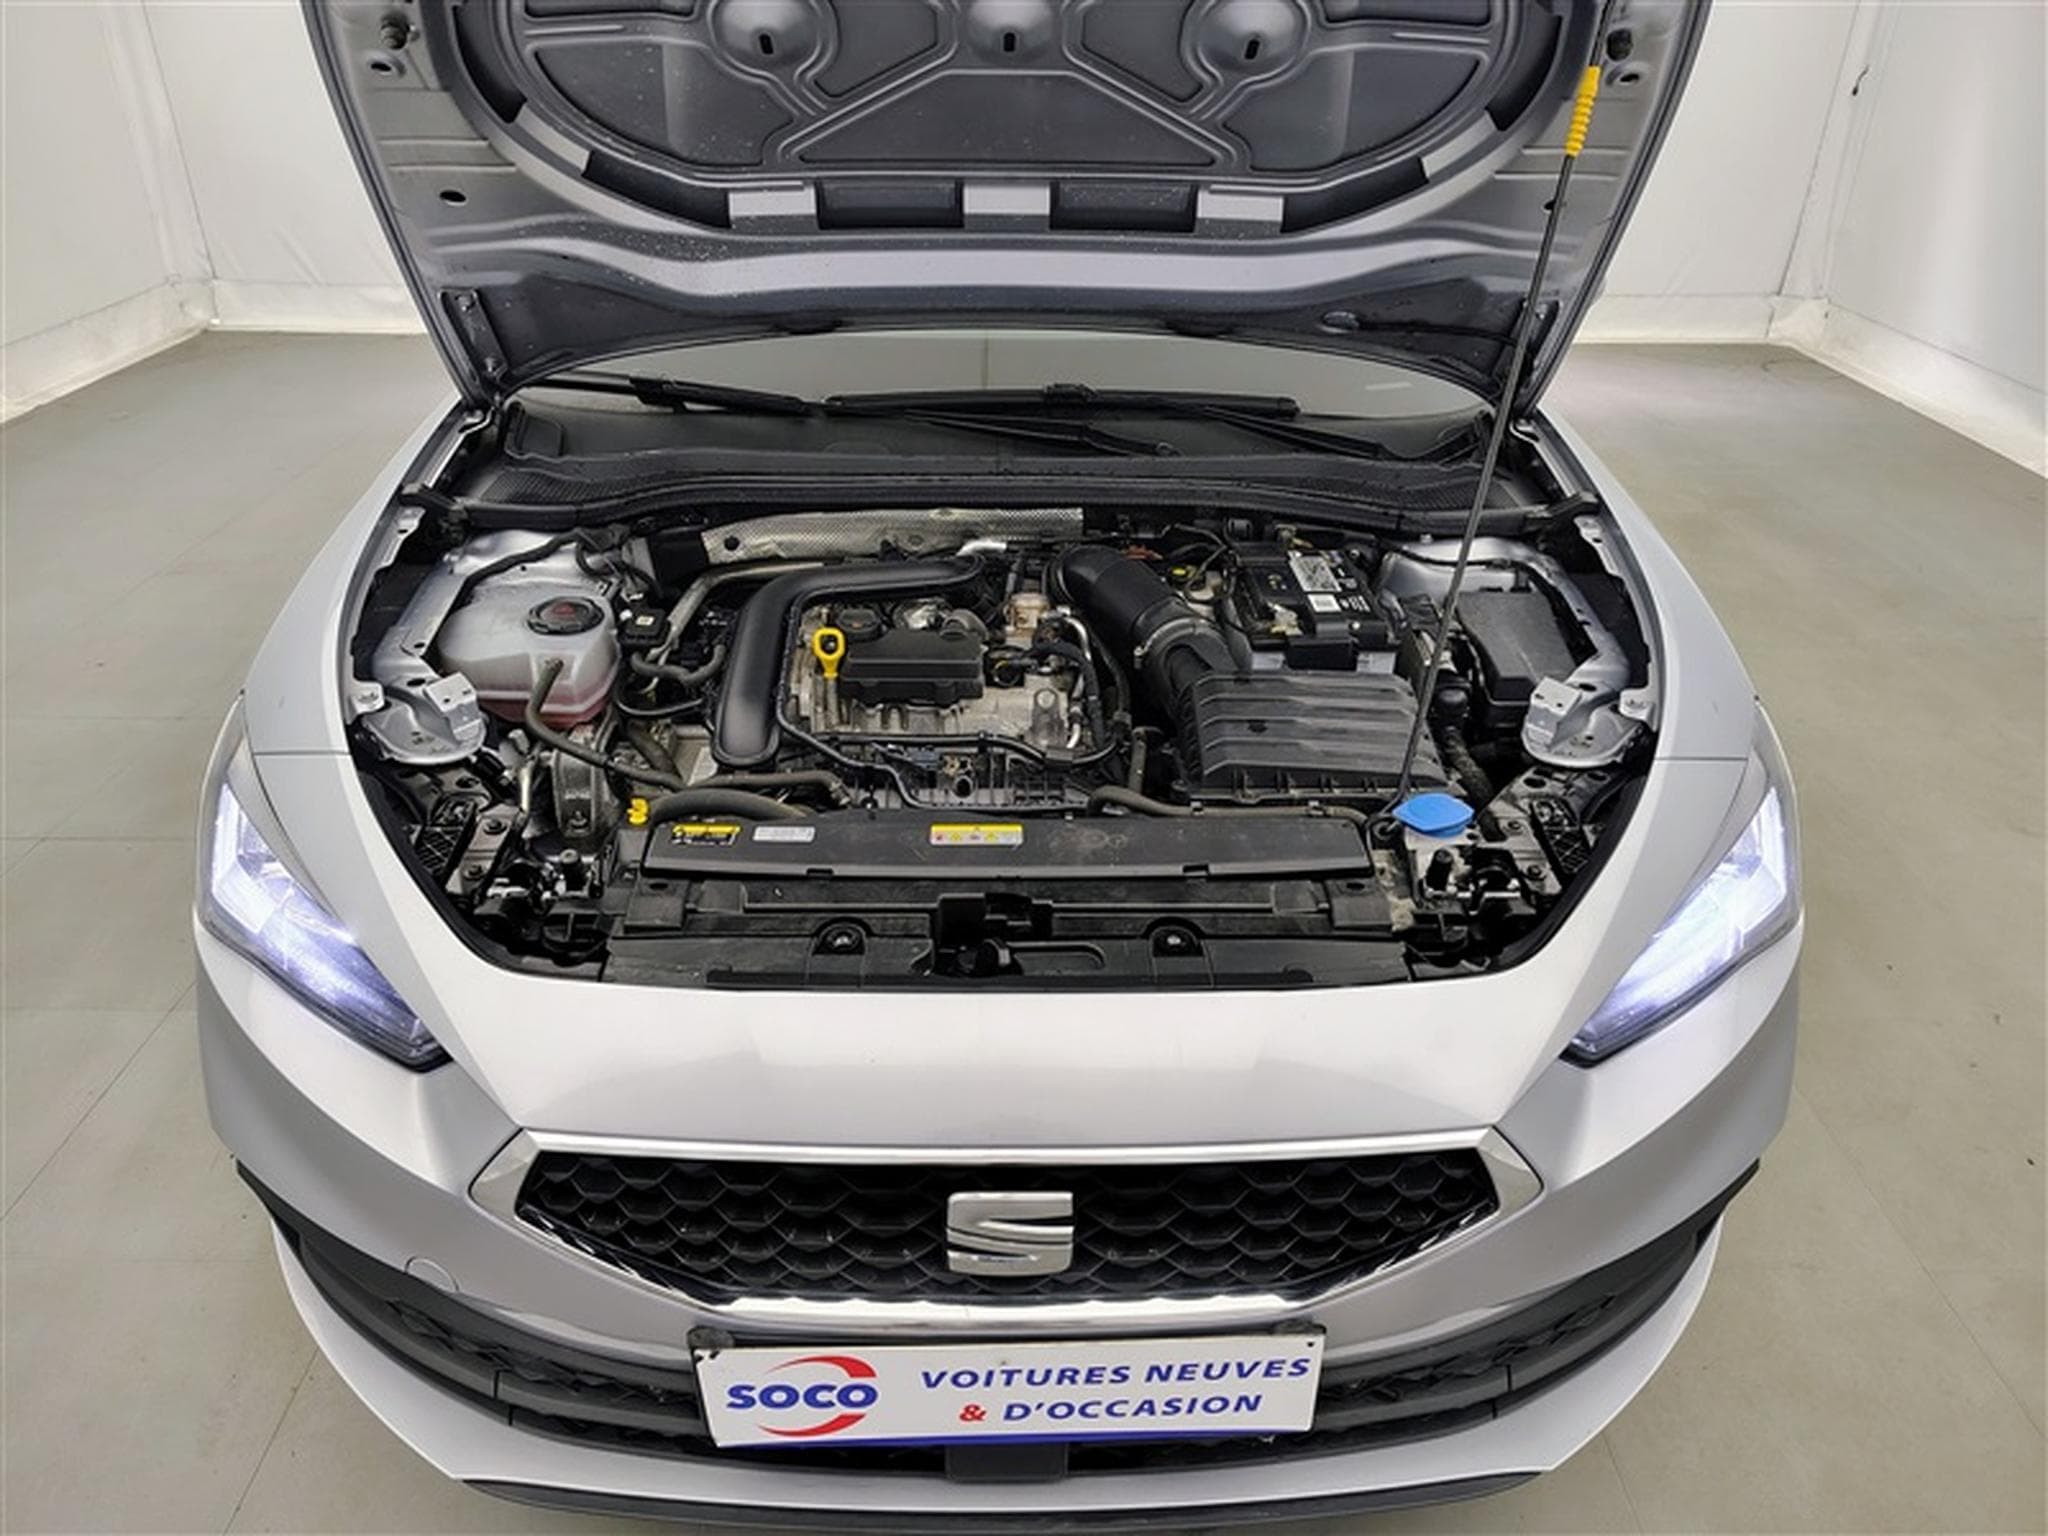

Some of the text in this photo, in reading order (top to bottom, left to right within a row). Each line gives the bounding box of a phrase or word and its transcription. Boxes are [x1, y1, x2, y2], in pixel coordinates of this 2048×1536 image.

[921, 1356, 1312, 1390] VOITURES NEUVES
[725, 1382, 879, 1410] SOCO
[958, 1394, 1264, 1423] & D'OCCASION
